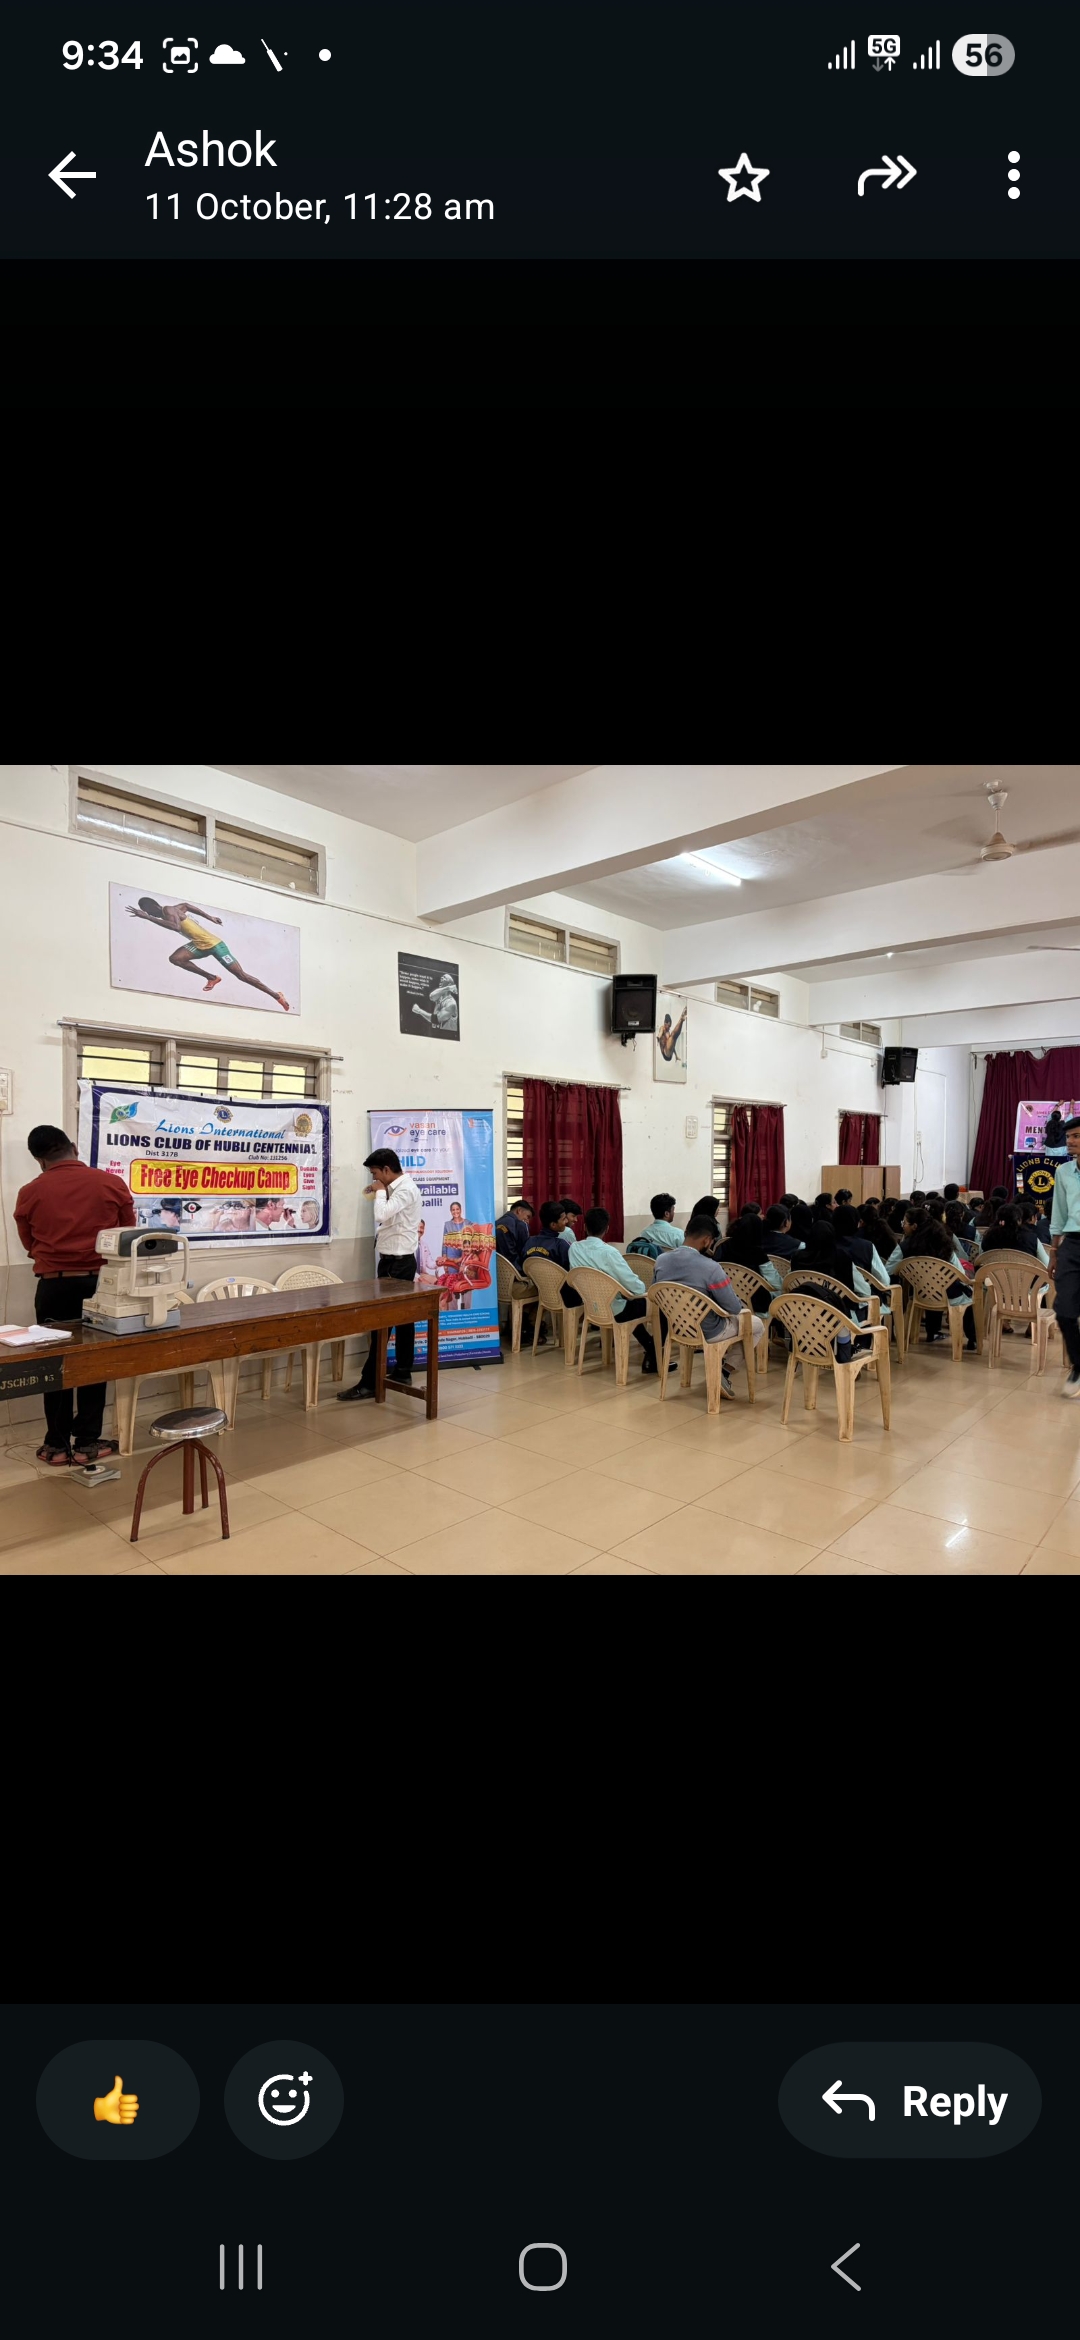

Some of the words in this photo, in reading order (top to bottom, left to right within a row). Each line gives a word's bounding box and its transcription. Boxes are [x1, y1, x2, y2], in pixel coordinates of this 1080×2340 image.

[155, 1119, 194, 1134] Lions
[199, 1123, 286, 1139] International
[107, 1134, 150, 1147] LIONS
[155, 1137, 191, 1149] CLUB
[195, 1140, 211, 1150] OF
[214, 1140, 250, 1152] HUBLI
[253, 1143, 317, 1154] CENTENNIAL
[400, 1156, 426, 1167] HILD
[1016, 1158, 1040, 1172] LIONS
[1043, 1158, 1060, 1168] CLU
[141, 1164, 172, 1187] Free
[175, 1166, 198, 1189] Eye
[202, 1166, 254, 1190] Checkup
[257, 1167, 290, 1190] Camp
[421, 1185, 457, 1194] vailable
